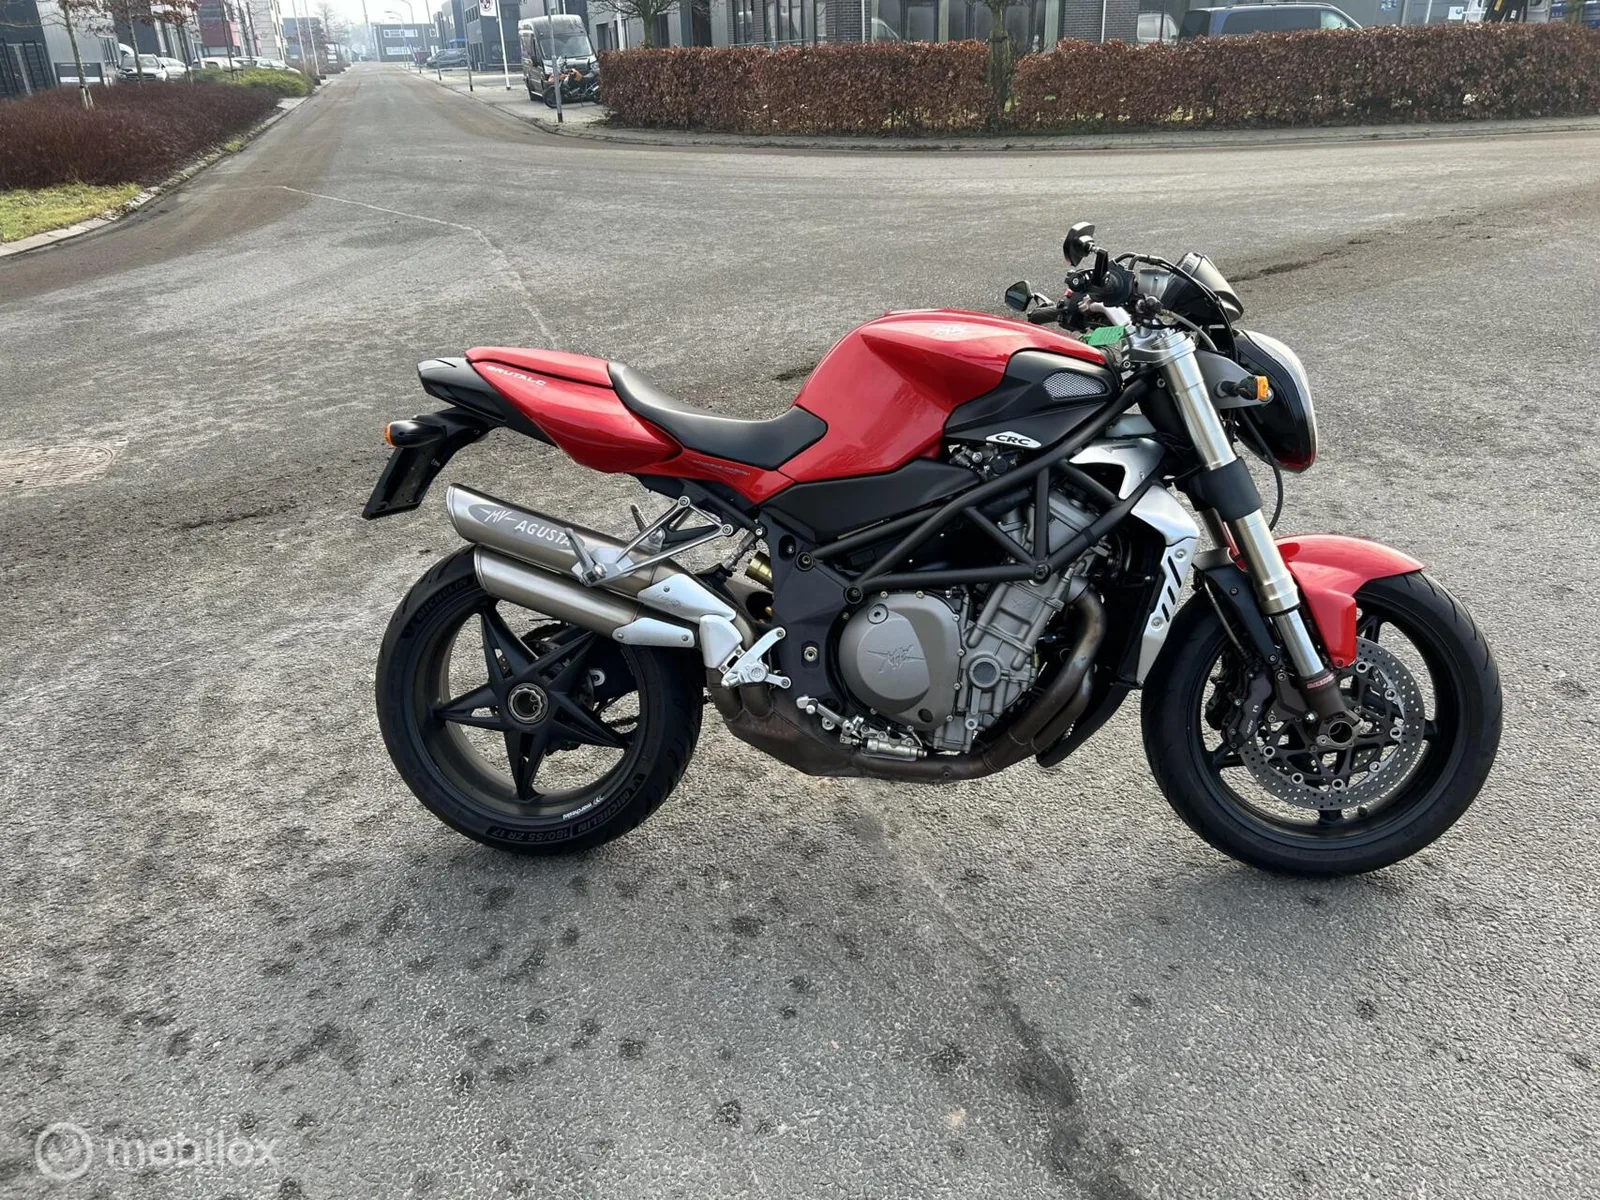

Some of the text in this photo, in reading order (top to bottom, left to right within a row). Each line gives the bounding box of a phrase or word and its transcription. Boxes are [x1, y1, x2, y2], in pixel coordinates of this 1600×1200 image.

[995, 434, 1031, 446] CRC
[483, 509, 571, 547] MV AGUSTA
[577, 791, 630, 833] MICHELIN
[493, 827, 506, 838] 17
